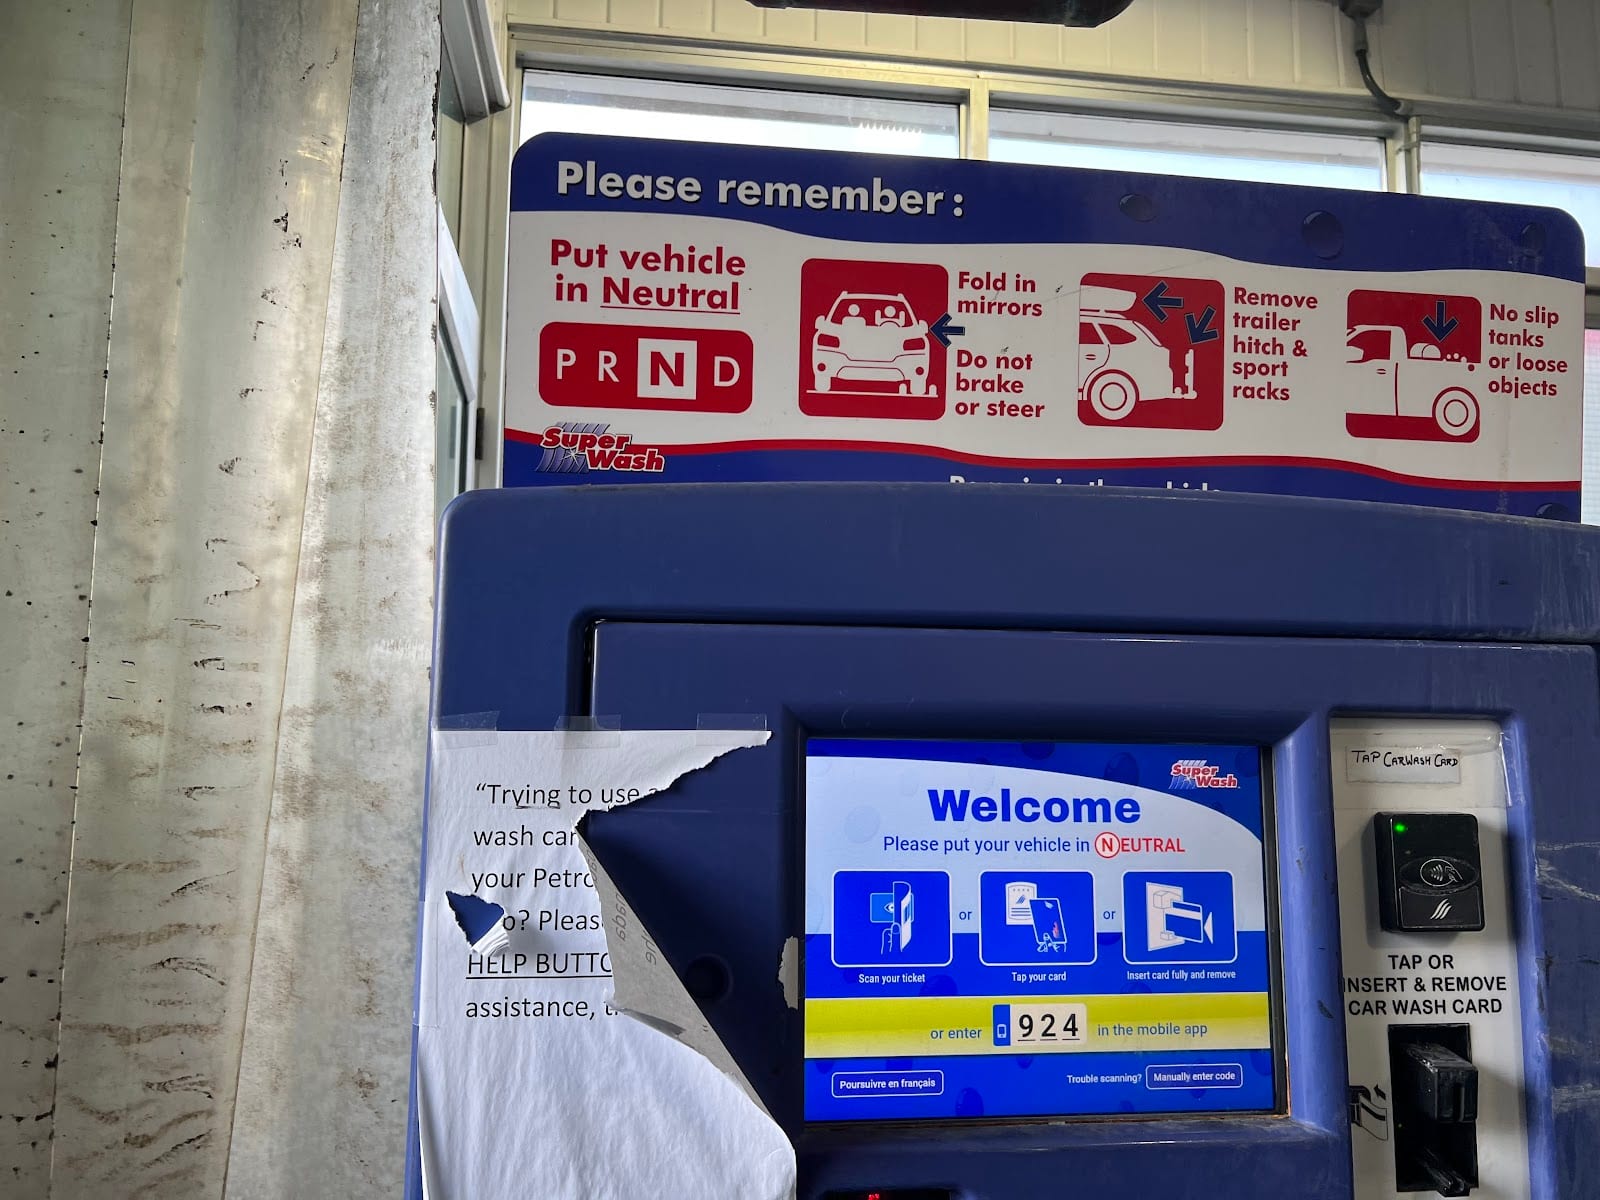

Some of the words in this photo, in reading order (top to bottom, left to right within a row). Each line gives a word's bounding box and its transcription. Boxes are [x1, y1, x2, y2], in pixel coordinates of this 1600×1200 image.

[557, 161, 702, 203] Please
[551, 239, 607, 269] Put
[620, 244, 746, 276] vehicle
[555, 273, 588, 303] in
[601, 276, 740, 311] Neutral
[958, 271, 1007, 292] Fold
[1015, 273, 1036, 293] in
[957, 296, 1043, 317] mirrors
[1233, 287, 1319, 309] Remove
[1233, 311, 1300, 332] trailer
[1491, 304, 1518, 323] No
[1524, 304, 1560, 327] slip
[1233, 336, 1284, 355] hitch
[1292, 339, 1308, 357] &
[1489, 328, 1544, 348] tanks
[557, 350, 576, 379] P
[598, 351, 619, 383] R
[650, 352, 684, 387] N
[714, 357, 740, 388] D
[957, 351, 987, 370] Do
[996, 354, 1033, 370] not
[1233, 360, 1288, 380] sport
[1489, 356, 1510, 370] or
[1516, 354, 1568, 373] loose
[956, 372, 1024, 394] brake
[1233, 382, 1290, 401] racks
[1488, 377, 1557, 397] objects
[955, 401, 980, 416] or
[987, 399, 1045, 419] steer
[542, 425, 632, 453] Super
[585, 449, 665, 472] Wash
[1171, 764, 1219, 779] Super
[1196, 774, 1239, 789] Wash
[569, 786, 592, 804] to
[602, 787, 640, 804] use
[928, 789, 1141, 824] Welcome
[474, 825, 533, 846] wash
[884, 837, 939, 852] Please
[943, 838, 970, 855] put
[973, 840, 1011, 855] your
[1015, 837, 1070, 852] vehicle
[1075, 838, 1090, 852] in
[1098, 836, 1185, 855] NEUTRAL
[472, 873, 525, 892] your
[539, 909, 604, 931] Pleas
[959, 910, 972, 920] or
[1103, 909, 1116, 920] or
[468, 954, 527, 974] HELP
[1388, 955, 1423, 970] TAP
[1429, 955, 1454, 969] OR
[859, 974, 880, 984] Scan
[882, 976, 901, 986] your
[903, 973, 925, 983] ticket
[1012, 972, 1026, 983] Tap
[1028, 974, 1046, 984] your
[1048, 971, 1067, 982] card
[1127, 970, 1150, 980] Insert
[1153, 970, 1170, 980] card
[1172, 970, 1188, 982] fully
[1190, 970, 1206, 980] and
[1208, 971, 1236, 979] remove
[1414, 977, 1426, 992] &
[1432, 977, 1506, 992] REMOVE
[466, 997, 595, 1020] assistance,
[1349, 1000, 1387, 1015] CAR
[1393, 1000, 1446, 1015] WASH
[1453, 999, 1502, 1014] CARD
[931, 1029, 944, 1040] or
[948, 1028, 982, 1039] enter
[1098, 1024, 1109, 1036] in
[1113, 1023, 1133, 1036] the
[1137, 1022, 1180, 1036] mobile
[1184, 1024, 1208, 1038] app
[840, 1079, 886, 1090] Poursuivre
[888, 1081, 898, 1089] en
[900, 1078, 936, 1091] français
[1067, 1074, 1097, 1084] Trouble
[1100, 1074, 1142, 1086] scanning?
[1153, 1072, 1190, 1084] Manually
[1193, 1072, 1208, 1080] enter
[1211, 1071, 1235, 1080] code
